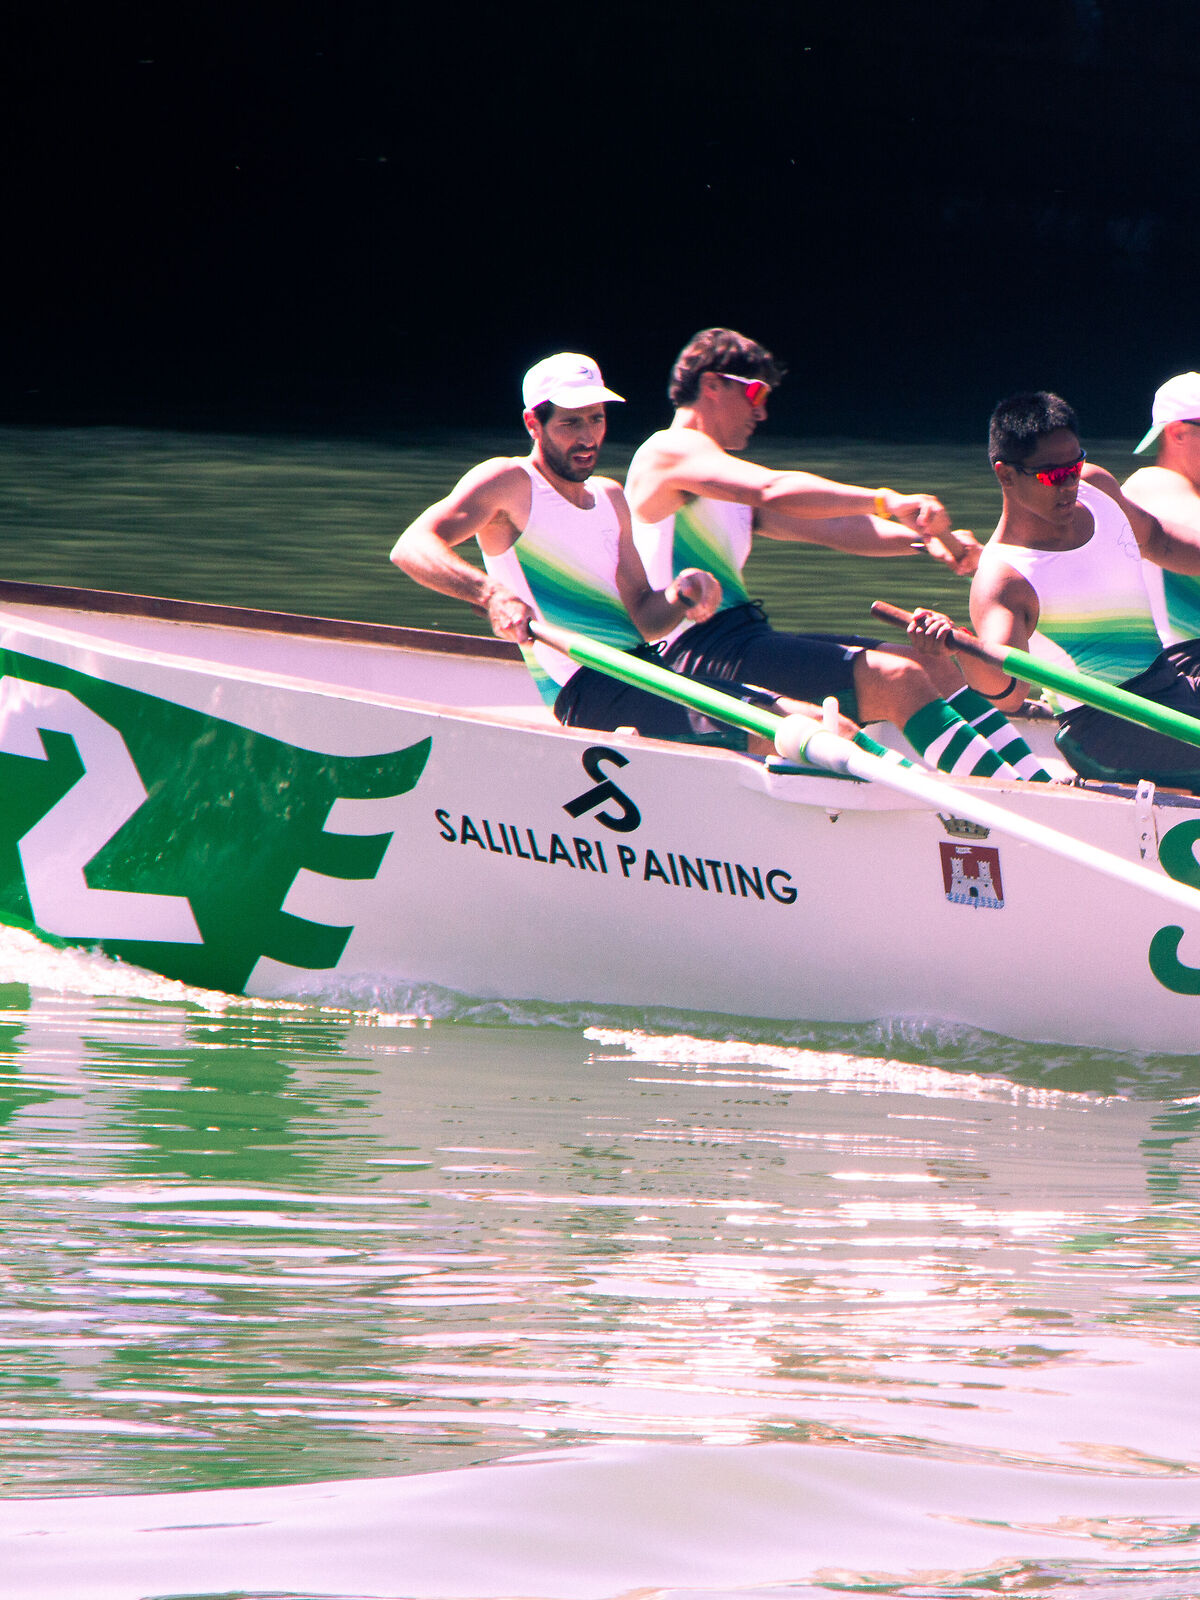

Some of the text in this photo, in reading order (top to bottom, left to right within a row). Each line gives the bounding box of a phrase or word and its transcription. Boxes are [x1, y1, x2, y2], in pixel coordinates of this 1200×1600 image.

[0, 676, 204, 944] 2
[435, 808, 798, 905] SALILLARI PAINTING
